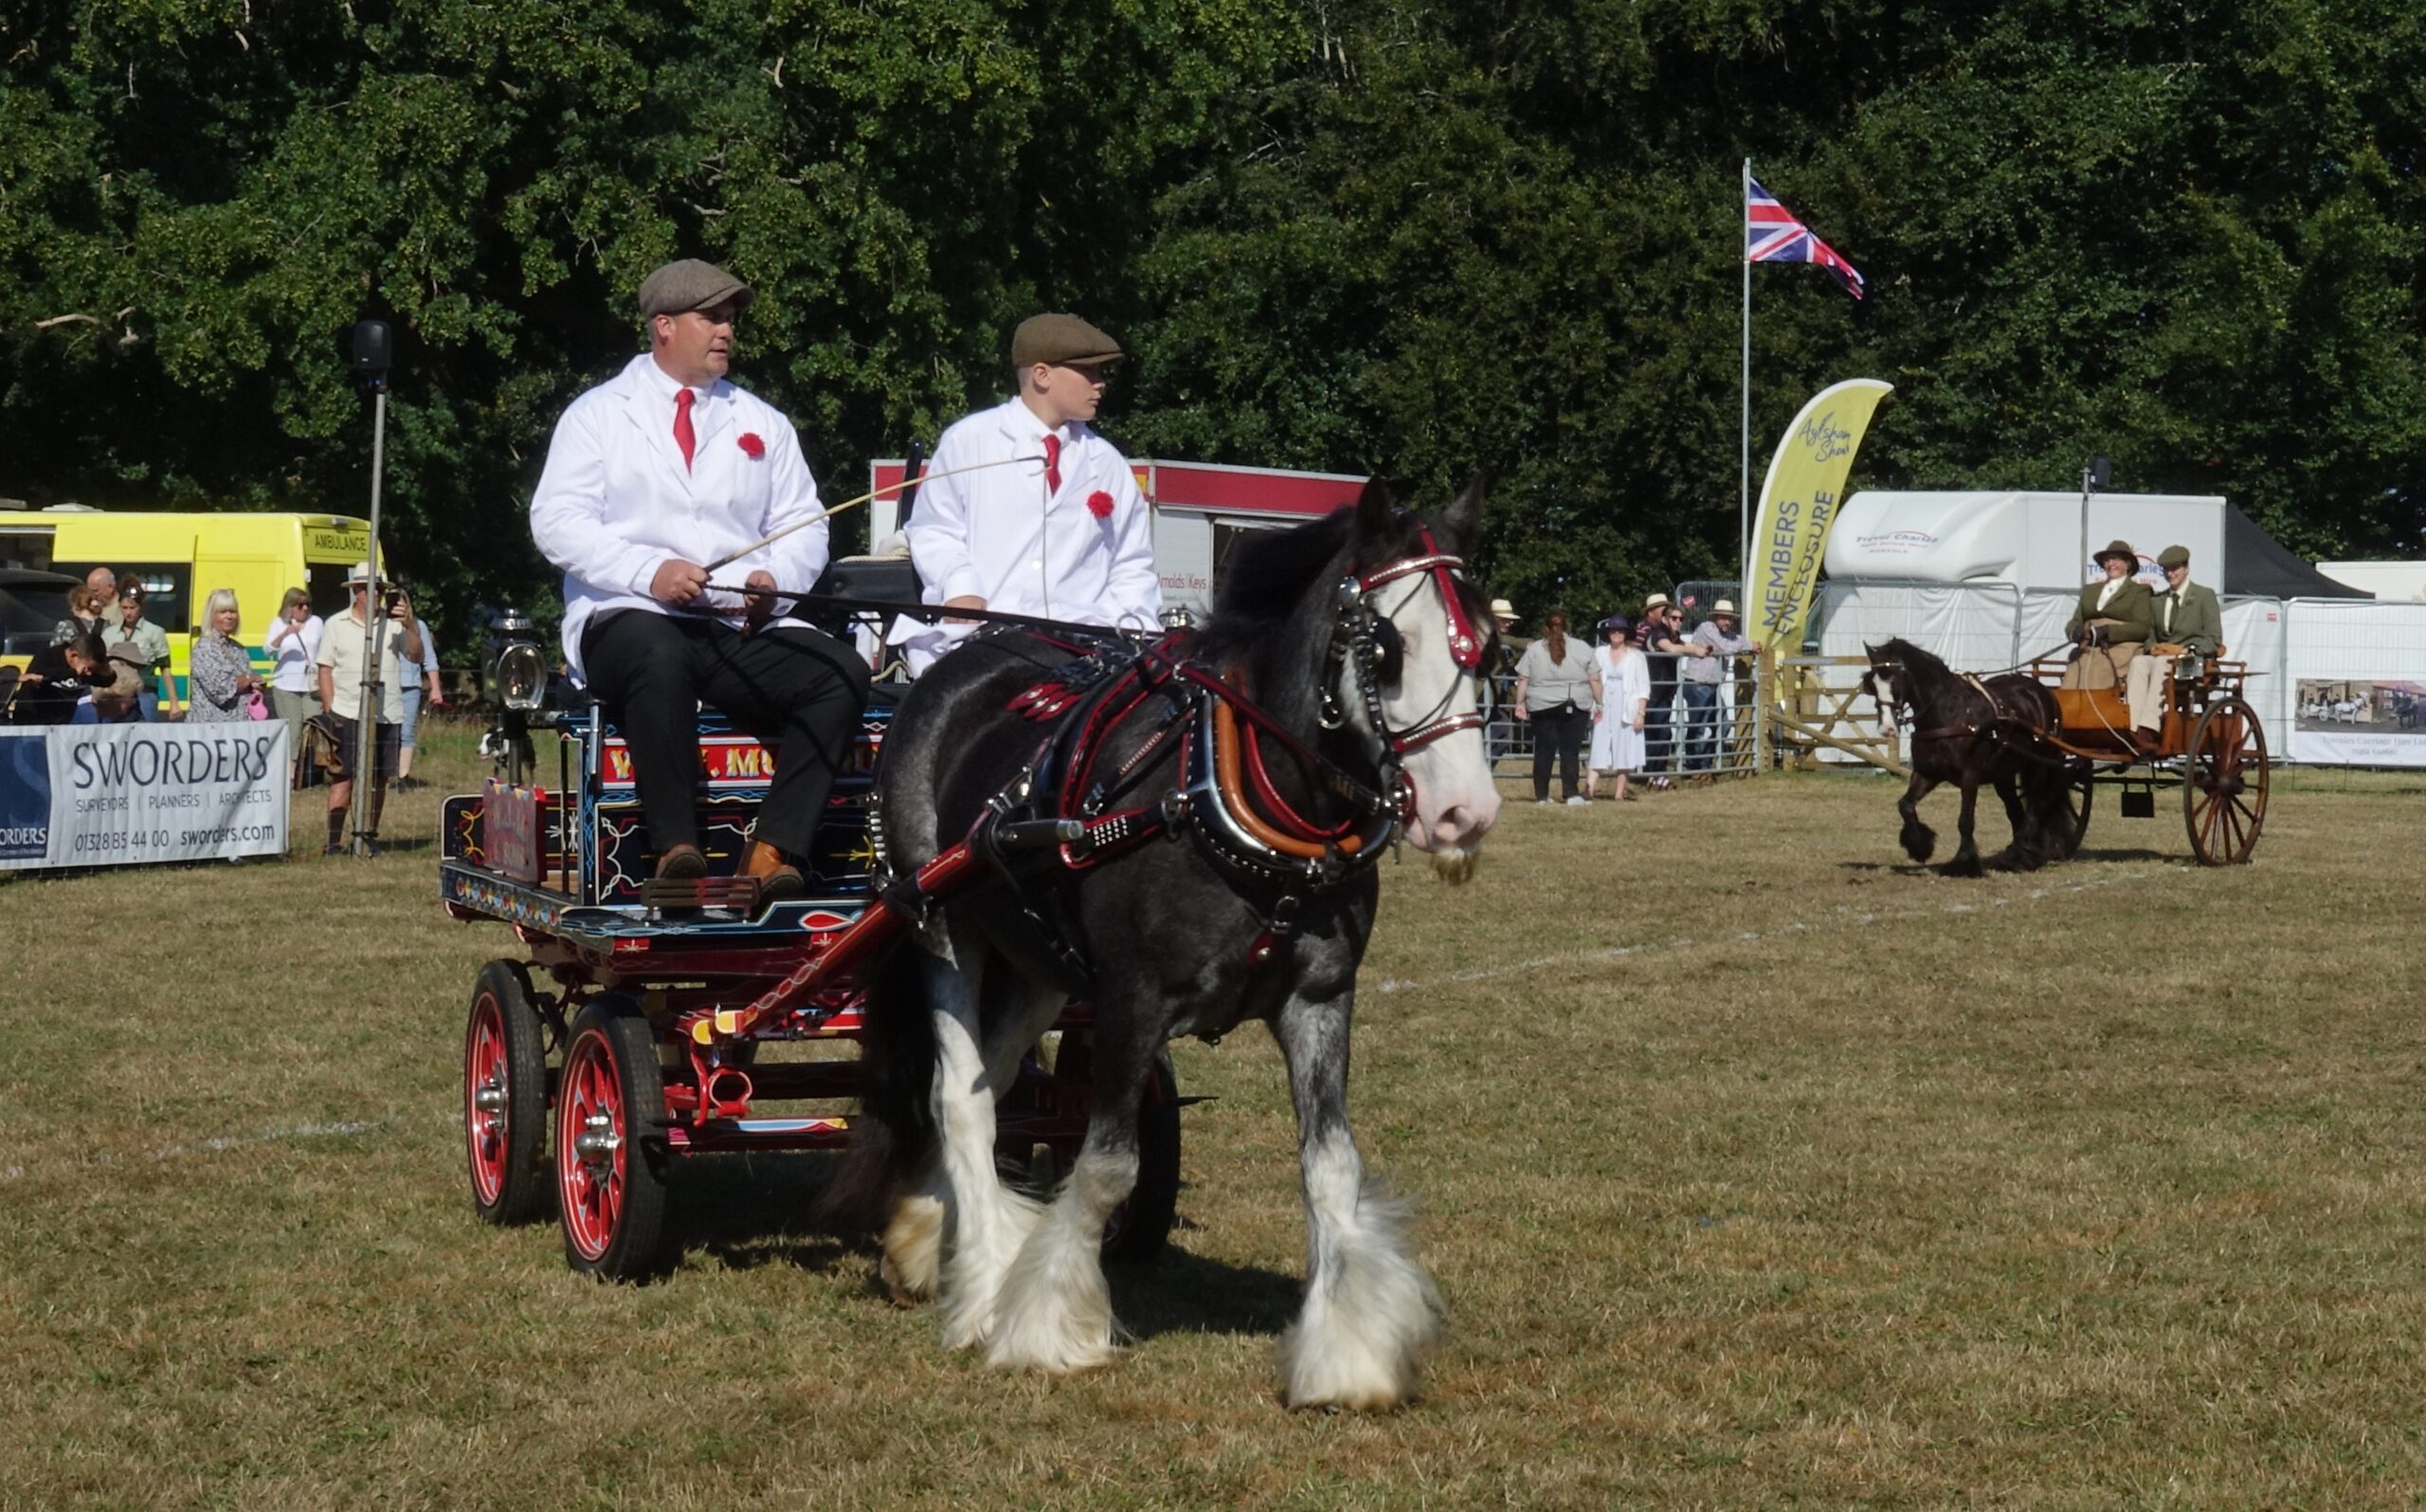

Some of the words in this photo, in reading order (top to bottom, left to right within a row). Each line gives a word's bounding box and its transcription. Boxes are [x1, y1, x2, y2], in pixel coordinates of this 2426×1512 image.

[315, 533, 367, 551] AMBULANCE
[1762, 500, 1800, 628] MEMBERS
[1774, 491, 1834, 636] ENCLOSURE
[73, 736, 270, 790] SWORDERS
[76, 796, 129, 813] SURVEYORS
[149, 794, 200, 809] PLANNERS
[219, 789, 272, 805] ARCECTS
[75, 833, 110, 852] 01328
[112, 832, 127, 849] 85
[131, 831, 147, 848] 44
[152, 830, 169, 847] 00
[180, 824, 275, 846] sworders.com
